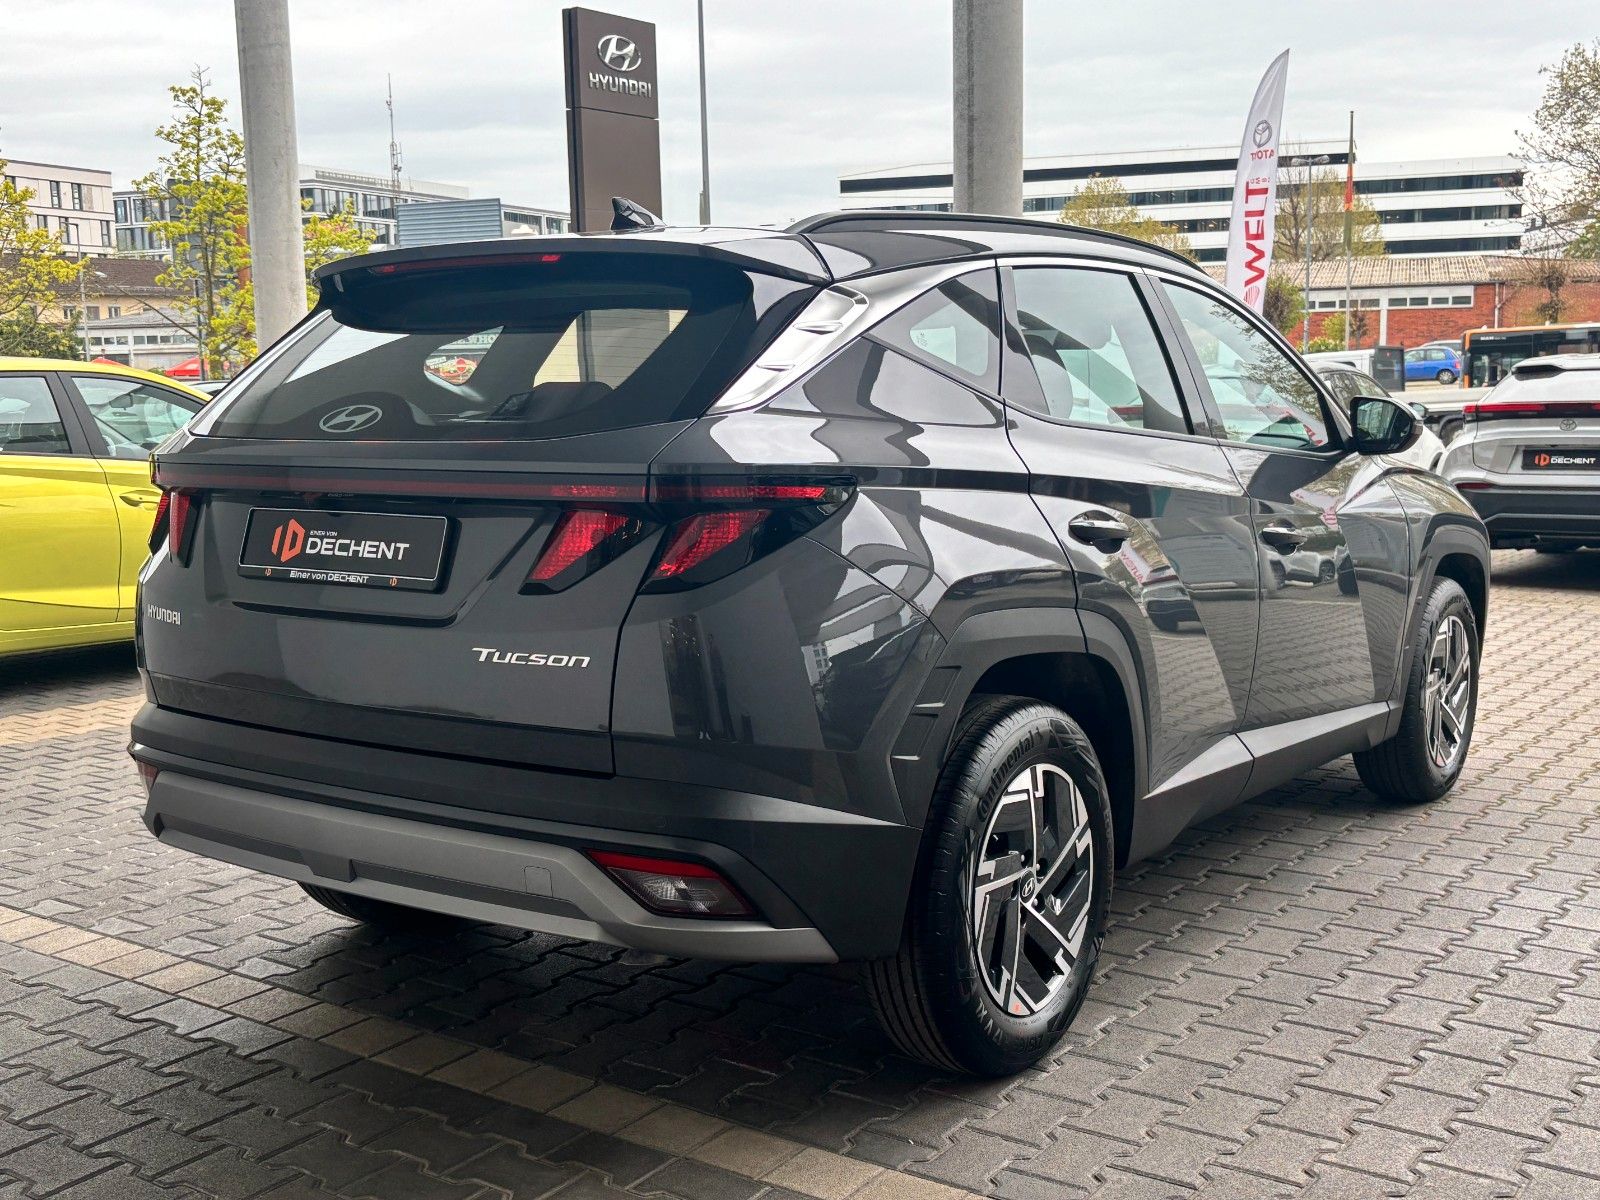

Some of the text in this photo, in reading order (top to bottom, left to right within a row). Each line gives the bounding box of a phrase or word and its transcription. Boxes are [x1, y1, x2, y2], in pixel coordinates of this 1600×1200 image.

[588, 71, 652, 98] HYUNDAI
[1550, 457, 1597, 465] DECHENT
[305, 537, 410, 561] DECHENT
[289, 570, 310, 580] Einer
[311, 572, 327, 581] von
[327, 573, 370, 584] DECHENT
[147, 603, 181, 626] HYUNDAI
[976, 729, 1036, 822] Continental
